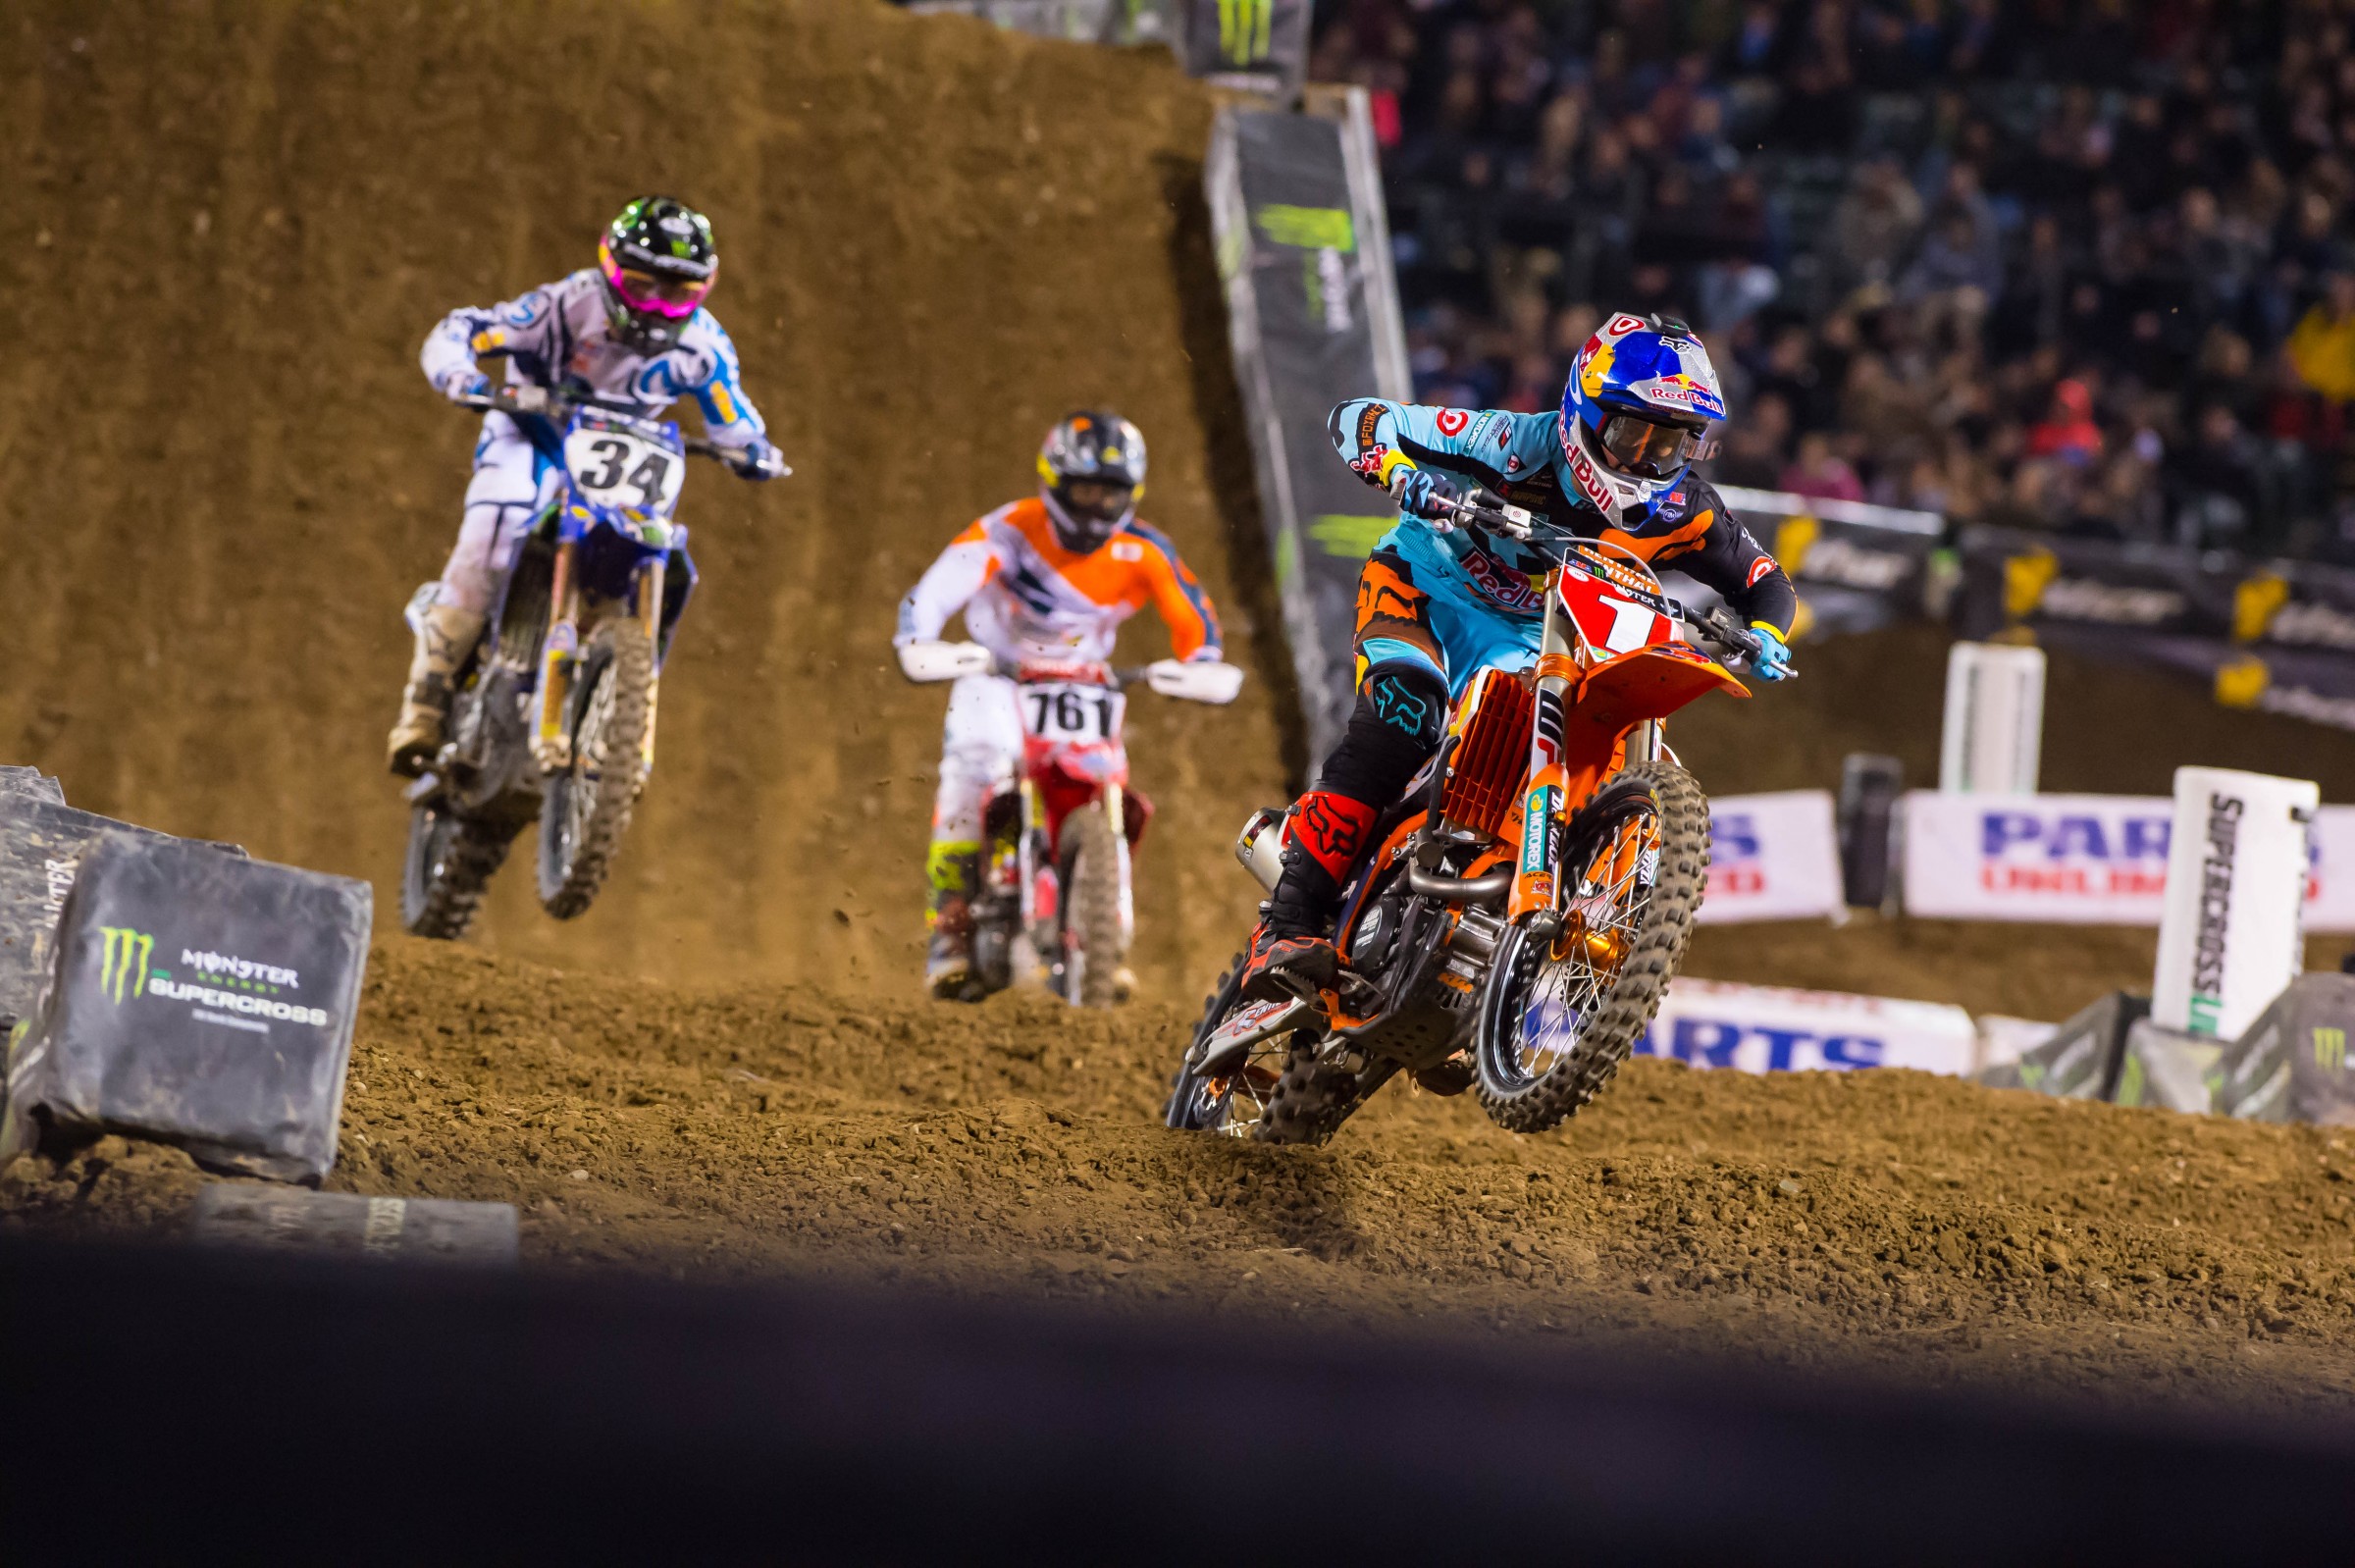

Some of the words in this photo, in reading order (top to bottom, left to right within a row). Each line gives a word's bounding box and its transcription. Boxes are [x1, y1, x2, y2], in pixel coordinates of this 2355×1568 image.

[1650, 387, 1688, 403] Red
[1690, 392, 1723, 415] Bull
[1467, 416, 1490, 449] MOTOREX
[580, 440, 669, 506] 34
[1558, 408, 1582, 464] Red
[1574, 457, 1614, 512] Bull
[1461, 551, 1527, 605] Red
[1597, 594, 1656, 654] 1
[1028, 691, 1112, 738] 761
[1527, 810, 1544, 871] MOTOREX
[181, 948, 299, 989] MONSTER
[149, 977, 328, 1026] SUPERCROSS
